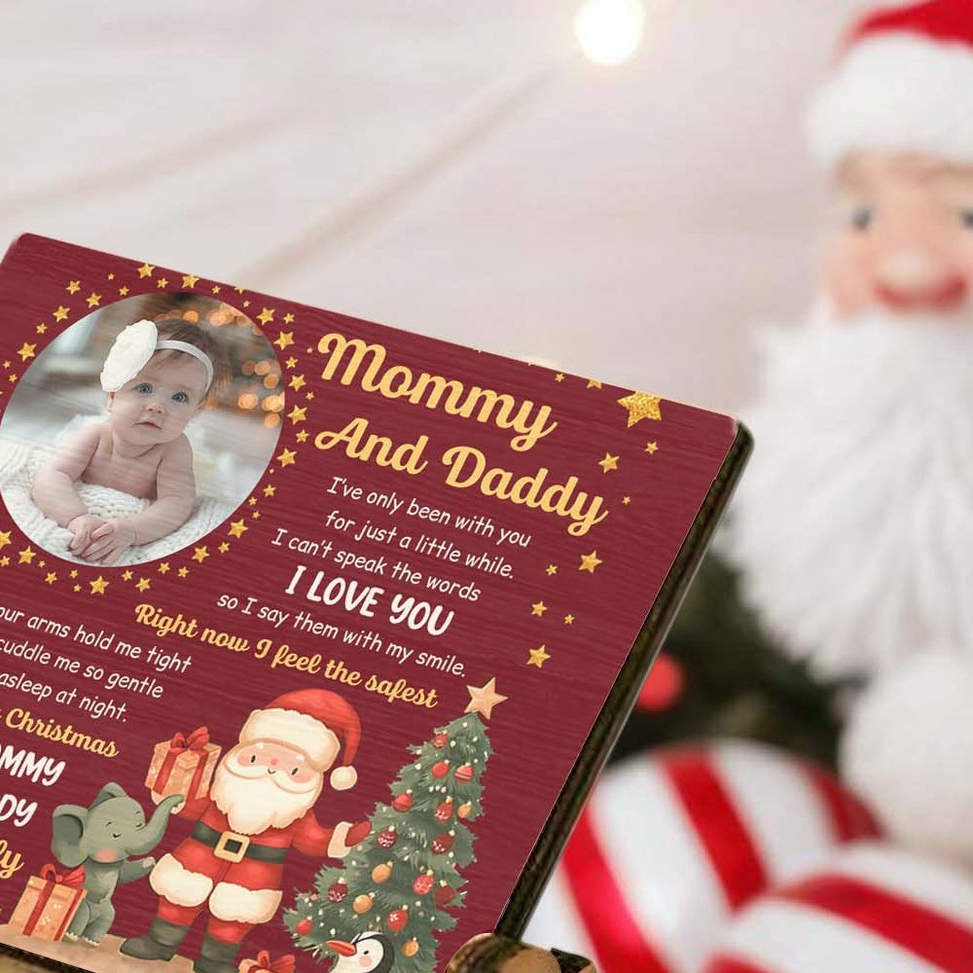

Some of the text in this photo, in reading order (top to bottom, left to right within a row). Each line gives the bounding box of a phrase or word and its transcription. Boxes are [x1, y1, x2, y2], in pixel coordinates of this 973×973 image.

[318, 333, 558, 452] Mommy
[315, 418, 609, 536] And Daddy
[327, 476, 531, 548] I've only been with you
[271, 528, 481, 601] I can't speak the words
[326, 510, 515, 579] for just a little while.
[217, 594, 466, 677] so I say them with my smile.
[285, 565, 455, 636] I LOVE YOU
[26, 612, 71, 637] arms
[73, 625, 110, 650] hold
[115, 641, 141, 658] me
[148, 649, 192, 673] tight
[54, 655, 79, 673] me
[83, 664, 105, 680] so
[107, 671, 164, 698] gentle
[134, 603, 438, 709] Right now I feel the safest
[5, 707, 119, 758] Christmas
[55, 689, 77, 704] at
[79, 696, 127, 722] night.
